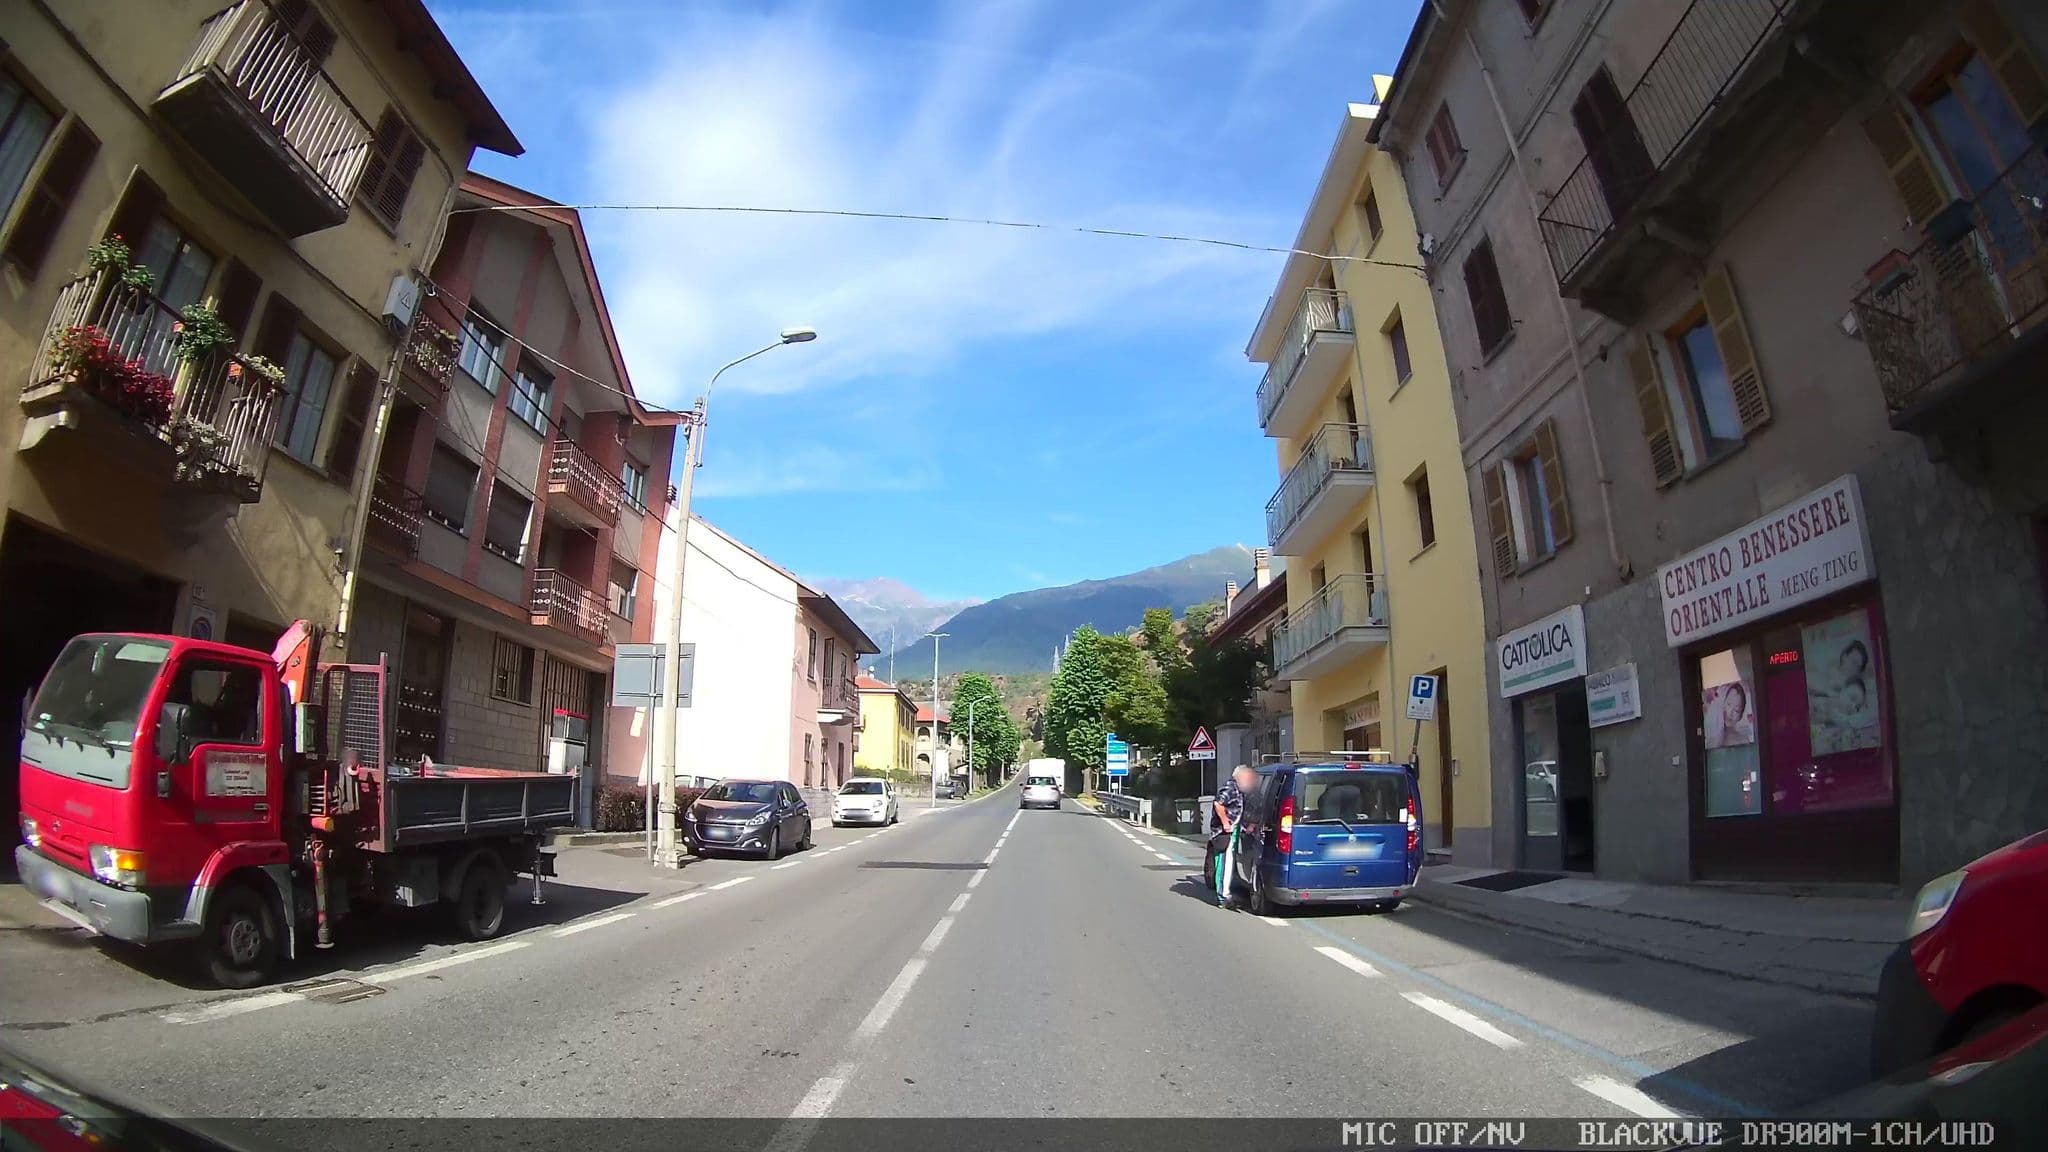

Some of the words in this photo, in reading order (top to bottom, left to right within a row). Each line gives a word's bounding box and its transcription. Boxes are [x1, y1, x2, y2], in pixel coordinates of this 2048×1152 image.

[1665, 546, 1732, 599] CENTRO
[1738, 489, 1850, 568] BENESSERE
[1670, 572, 1770, 637] ORIENTALE
[1780, 566, 1819, 599] MENG
[1822, 551, 1858, 581] TING
[1502, 623, 1573, 670] CATTOLICA
[1769, 650, 1799, 665] APERTO
[1417, 679, 1430, 695] P
